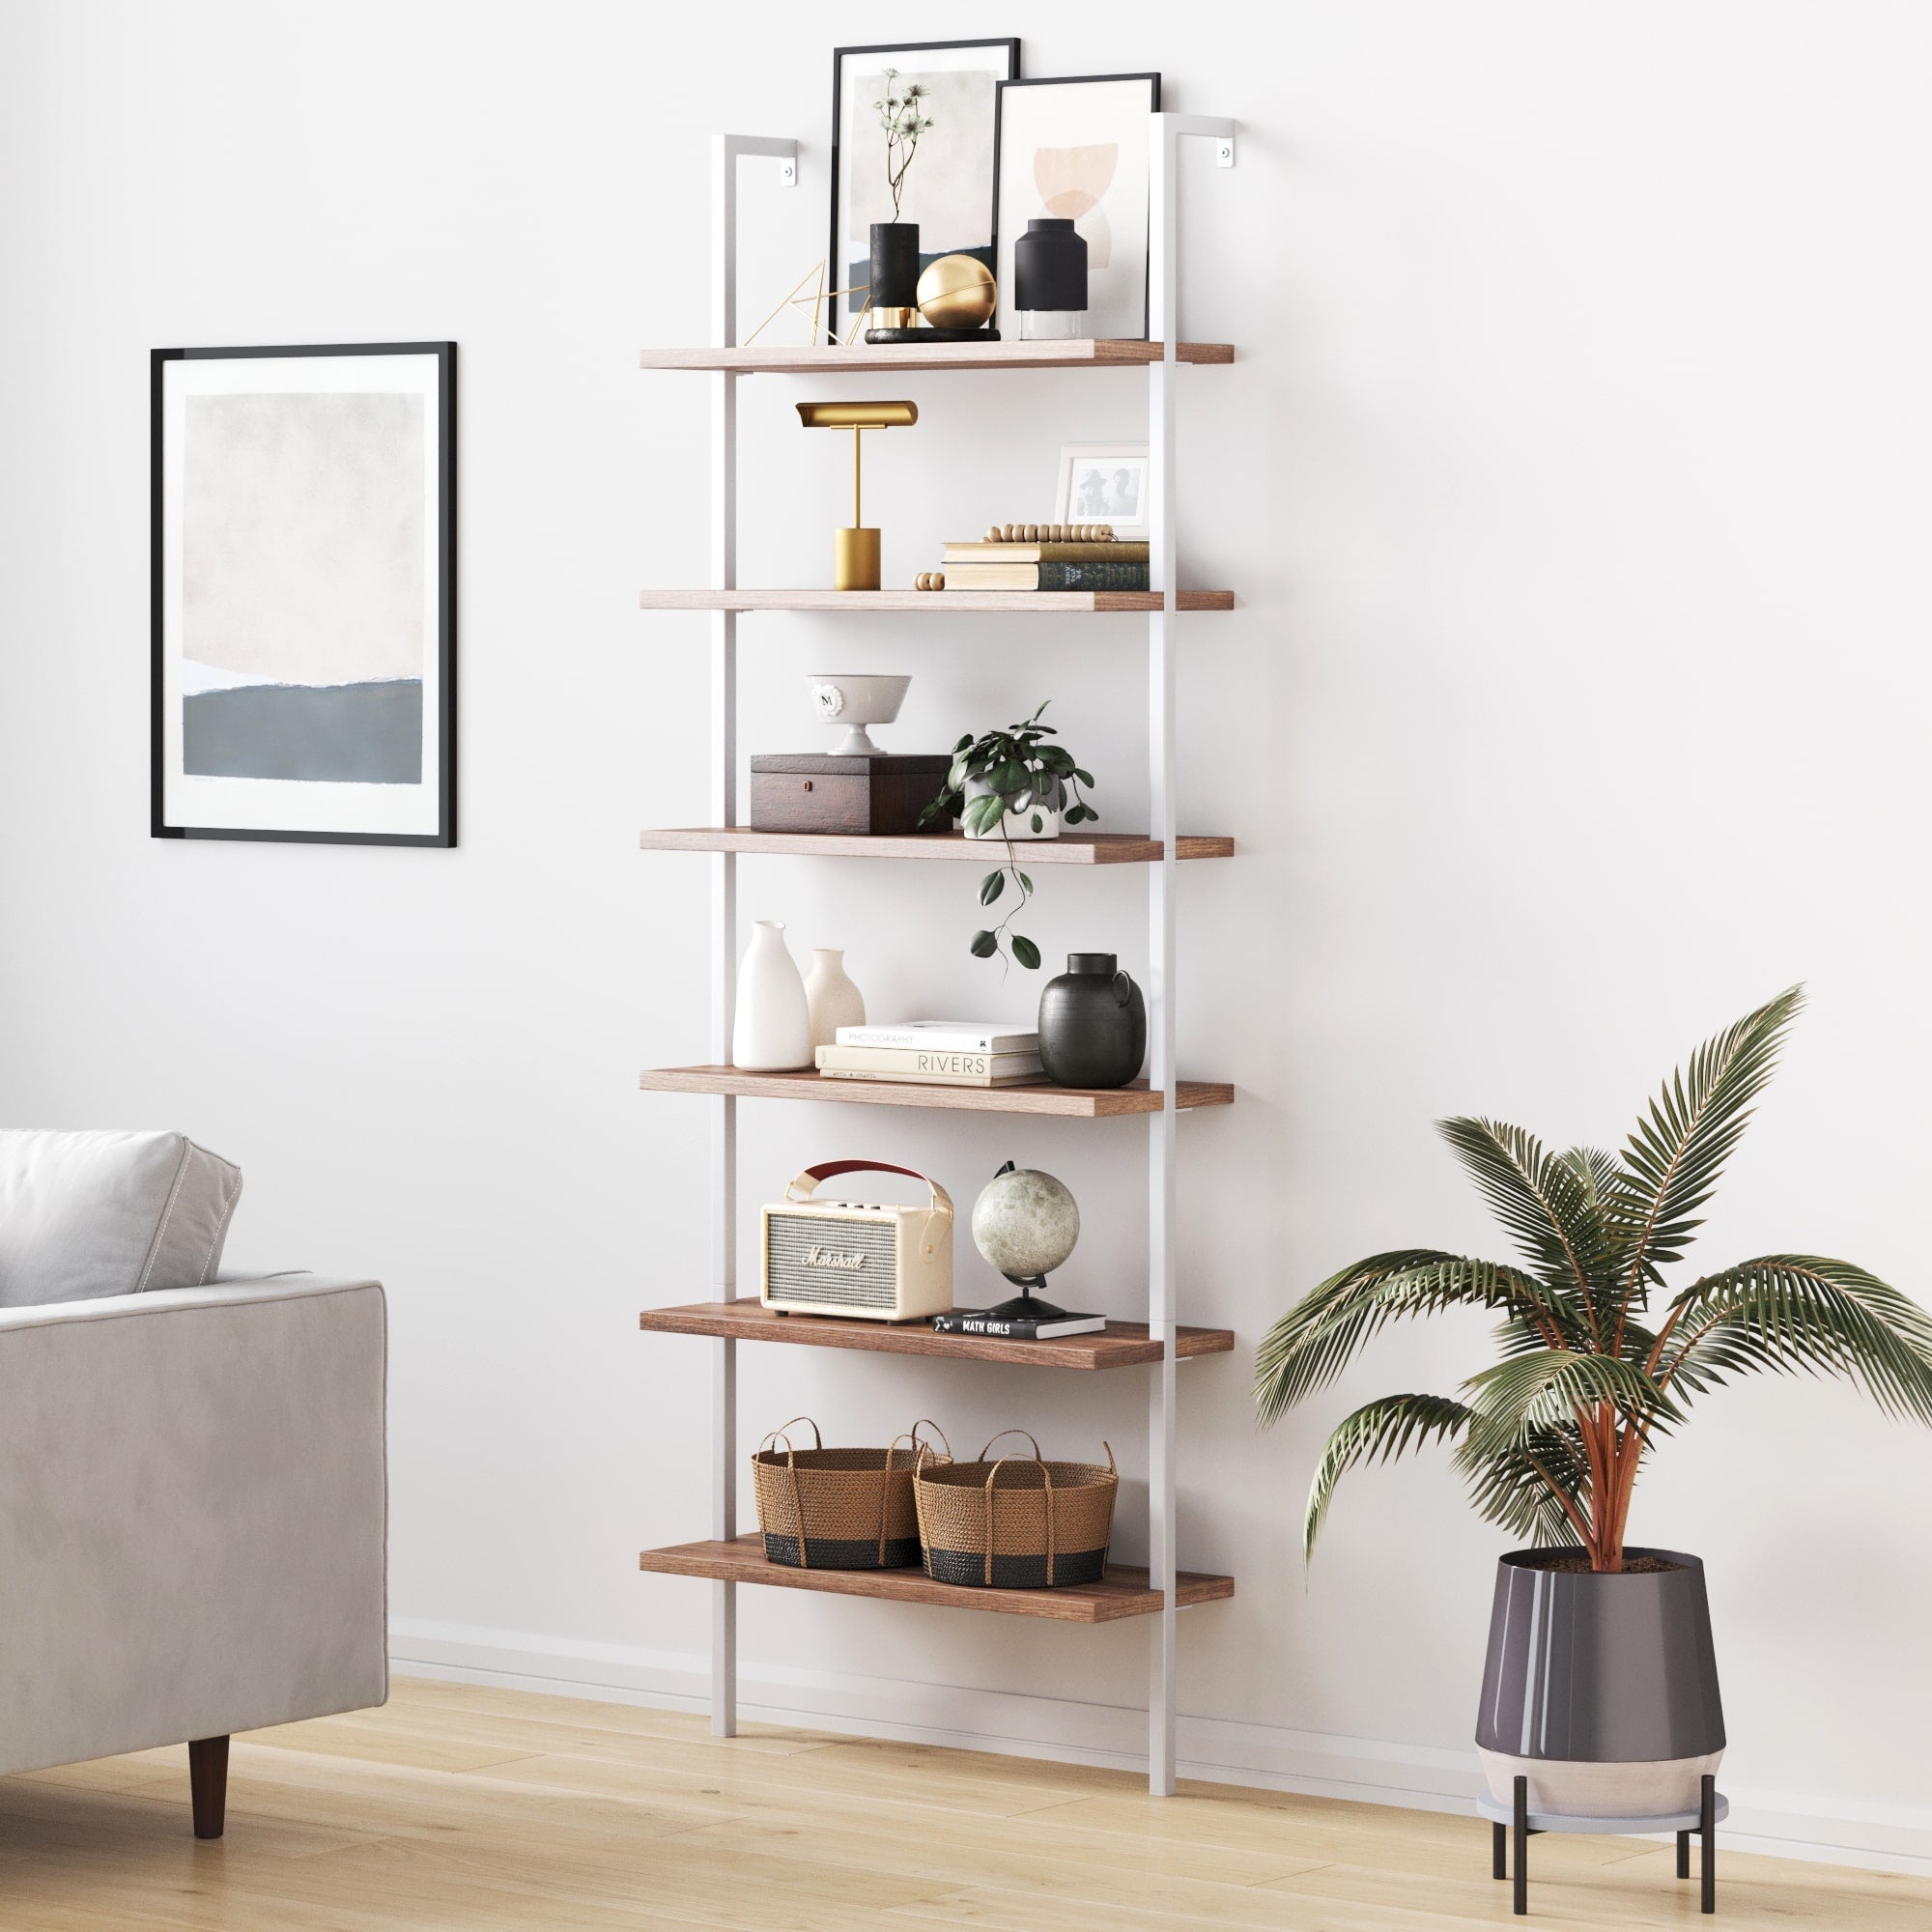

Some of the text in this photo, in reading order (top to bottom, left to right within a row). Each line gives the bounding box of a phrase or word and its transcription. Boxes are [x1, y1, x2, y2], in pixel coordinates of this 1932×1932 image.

[821, 696, 833, 706] M
[849, 1032, 914, 1044] PHOTOGRAPHY
[918, 1055, 985, 1074] RIVERS
[802, 1244, 866, 1269] Marshall
[962, 1320, 985, 1333] MATH
[986, 1322, 1010, 1335] GIRLS
